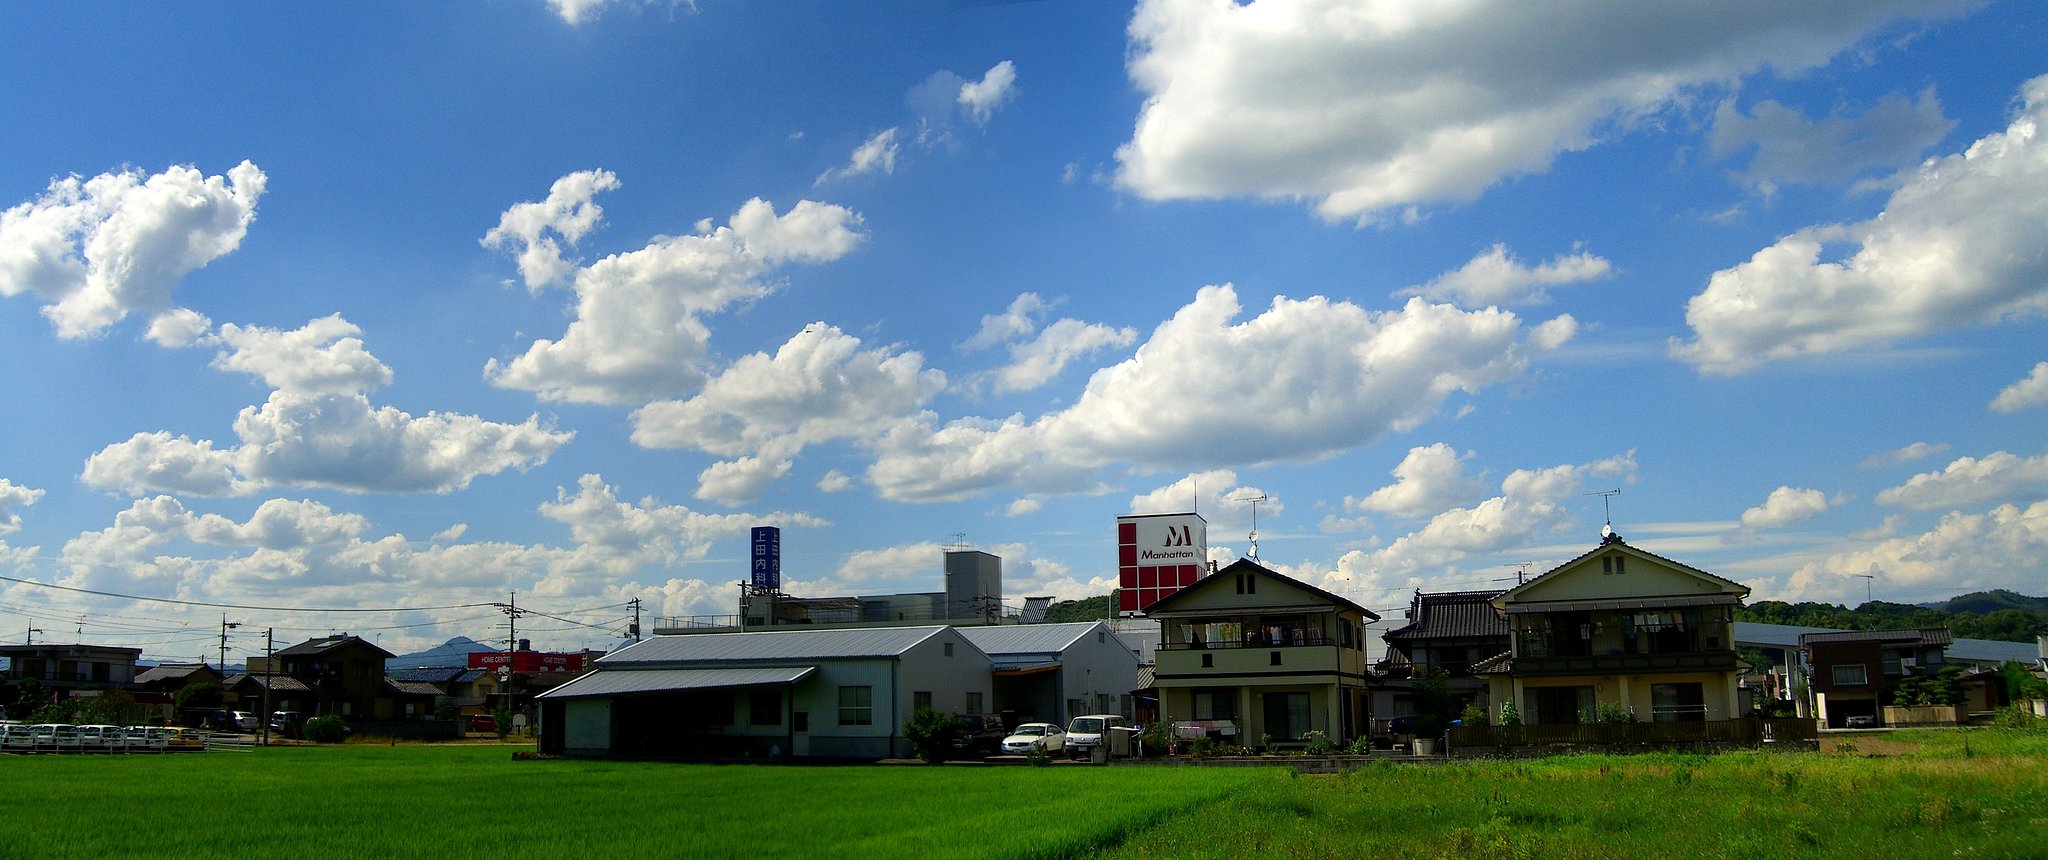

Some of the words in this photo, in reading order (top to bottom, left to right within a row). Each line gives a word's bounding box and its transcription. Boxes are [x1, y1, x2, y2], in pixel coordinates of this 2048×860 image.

[755, 531, 766, 583] 上田内科
[771, 530, 779, 585] 上田内科
[1141, 550, 1193, 559] Manhattan
